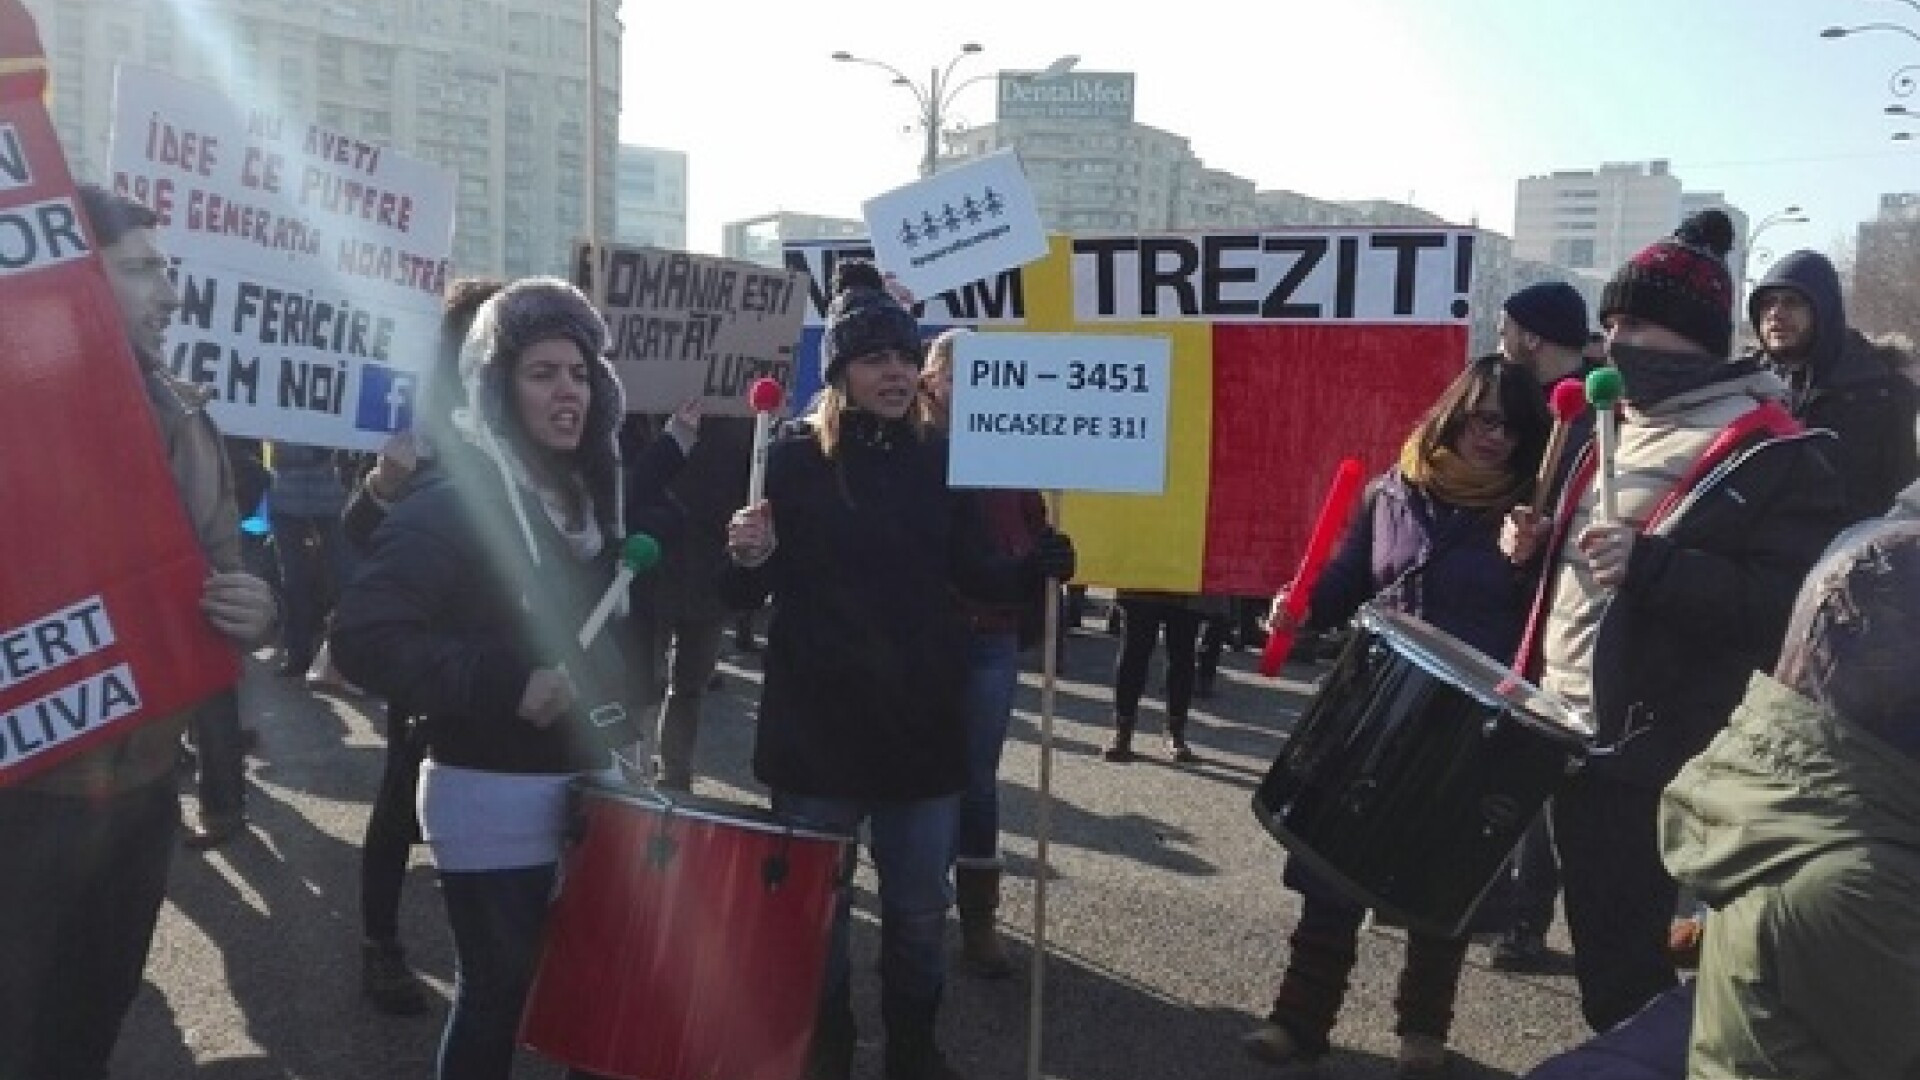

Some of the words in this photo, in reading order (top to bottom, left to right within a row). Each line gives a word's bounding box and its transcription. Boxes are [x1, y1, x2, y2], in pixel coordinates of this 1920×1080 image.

[241, 146, 285, 194] CE
[301, 166, 414, 233] PUTERE
[1073, 233, 1473, 319] TREZIT!
[232, 281, 395, 361] FERICIRE
[279, 357, 347, 415] NOI
[970, 360, 1028, 389] PIN
[1066, 360, 1149, 393] 3451
[967, 413, 1067, 436] INCASEZ
[1073, 416, 1103, 436] PE
[1109, 416, 1146, 440] 31!
[0, 604, 101, 678] ERT
[0, 672, 137, 760] LIVA
